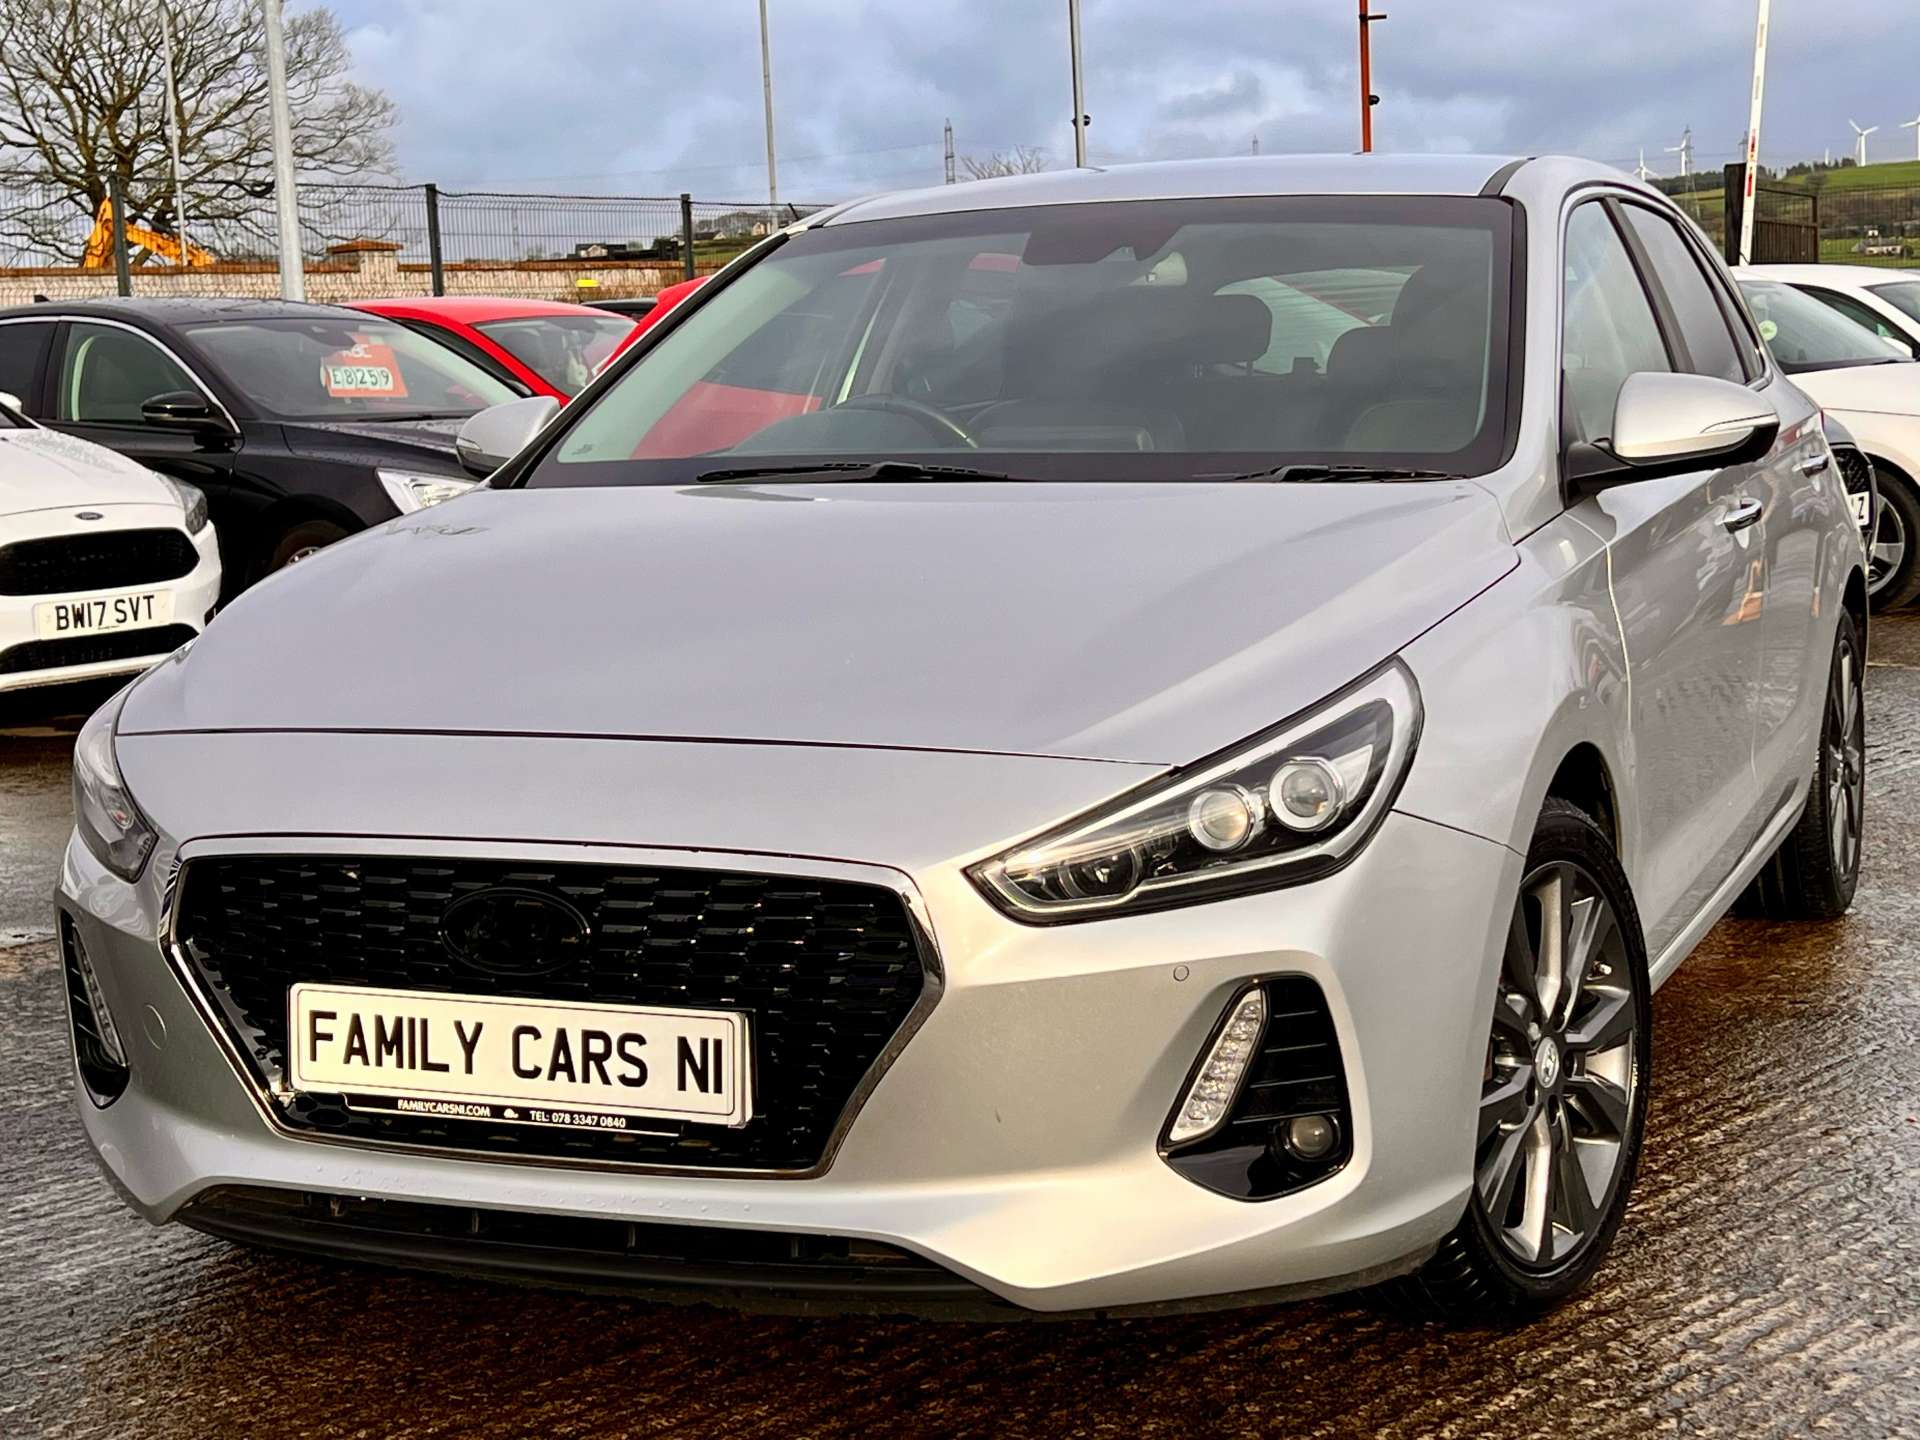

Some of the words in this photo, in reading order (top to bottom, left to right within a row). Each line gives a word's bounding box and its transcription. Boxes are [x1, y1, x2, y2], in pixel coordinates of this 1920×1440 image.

[55, 601, 107, 631] BW17
[114, 594, 155, 624] SVT
[308, 1009, 484, 1075] FAMILY
[511, 1024, 648, 1088] CARS
[397, 1098, 491, 1118] FAMILYCARSNI.COM
[529, 1110, 550, 1123] TEL:
[551, 1112, 571, 1124] 078
[572, 1114, 599, 1127] 3347
